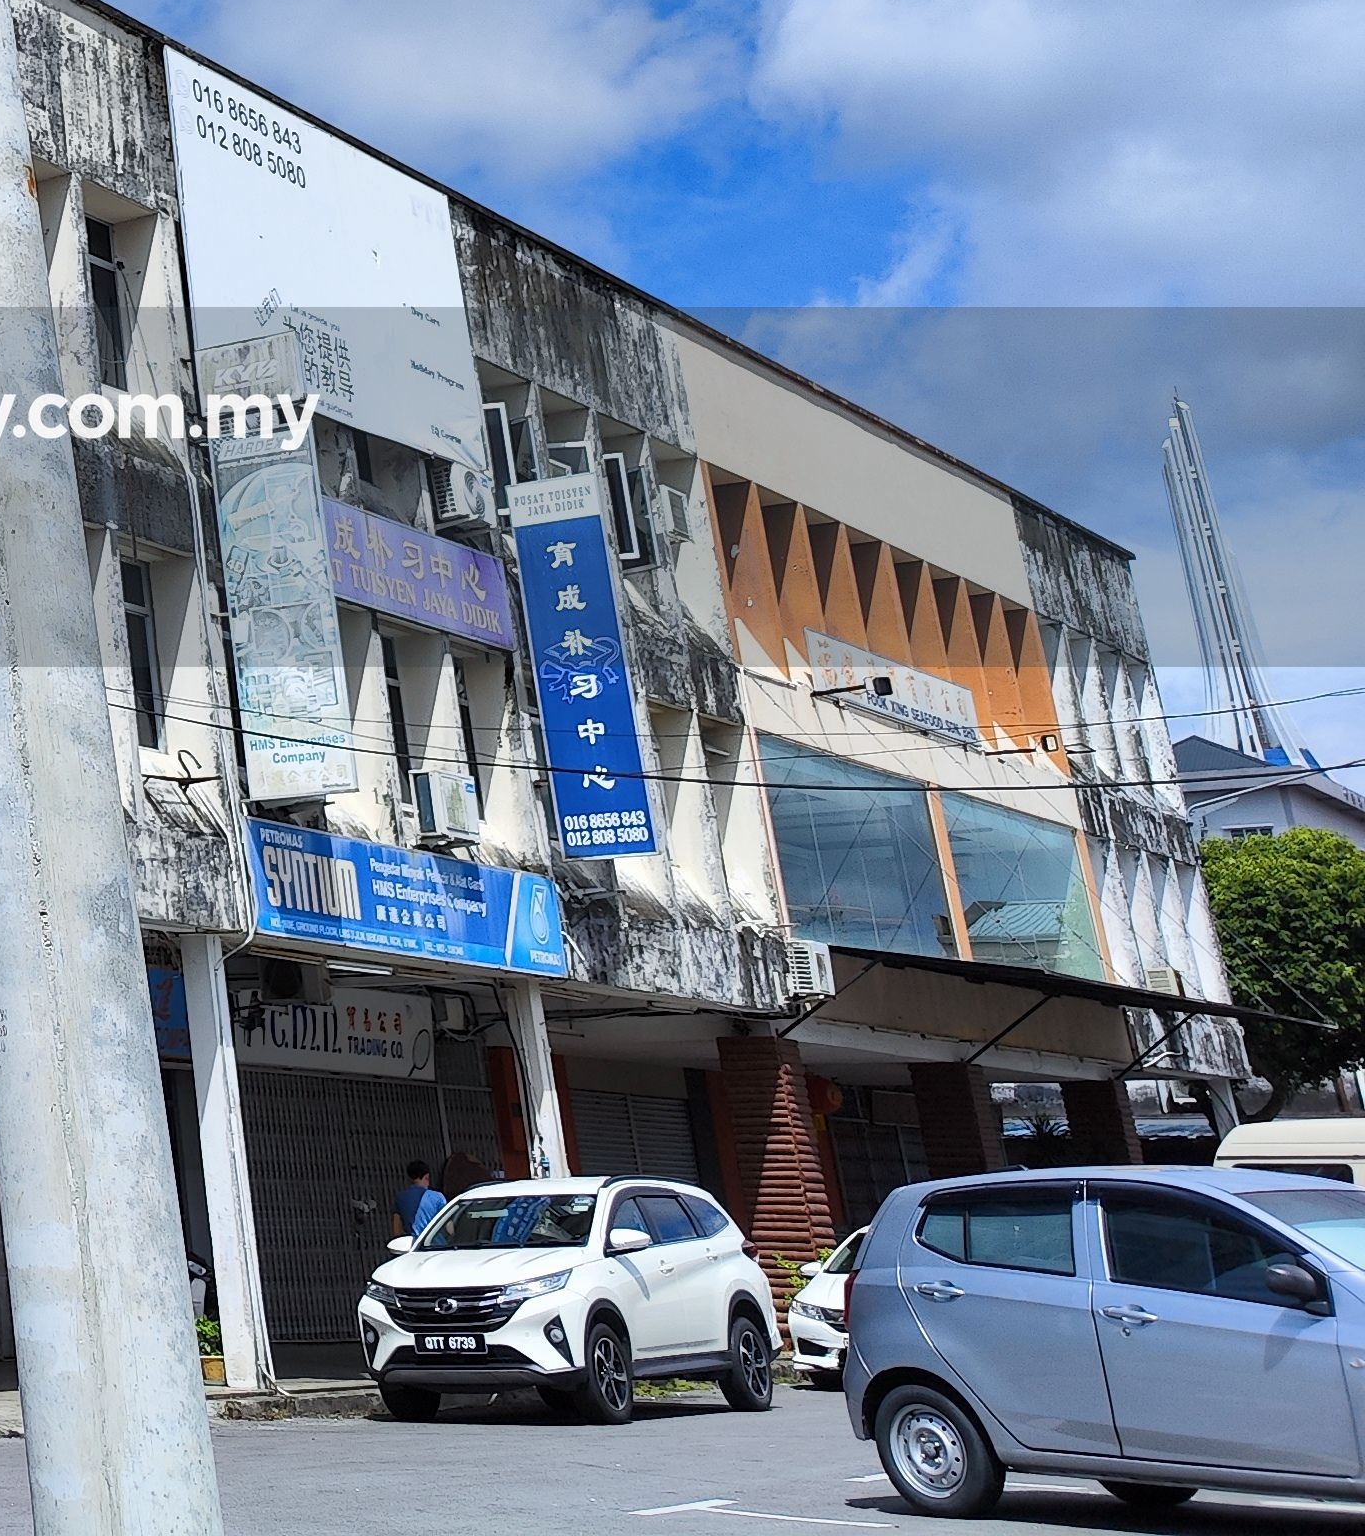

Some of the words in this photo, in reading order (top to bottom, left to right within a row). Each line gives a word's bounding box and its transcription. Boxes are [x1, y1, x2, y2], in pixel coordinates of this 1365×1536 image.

[193, 79, 223, 113] 016
[228, 97, 268, 137] 8656
[272, 121, 301, 154] 843
[197, 115, 228, 150] 012
[232, 133, 262, 166] 808
[267, 151, 305, 188] 5080
[514, 492, 544, 507] PUSAT
[548, 486, 591, 503] TUISYEN
[528, 504, 551, 517] JAYA
[555, 498, 584, 512] DIDIK
[350, 564, 417, 606] TUISYEN
[422, 588, 460, 621] JAYA
[461, 601, 503, 635] DIDIK
[546, 541, 616, 790] 育成补习中心
[911, 708, 943, 729] SEAFOOD
[250, 738, 275, 751] HMS
[280, 733, 346, 750] Enprises
[273, 751, 326, 764] Company
[564, 815, 588, 830] 016
[589, 812, 620, 829] 8656
[621, 810, 646, 826] 843
[260, 827, 303, 849] PETRONAS
[567, 831, 591, 846] 012
[592, 829, 616, 845] 808
[618, 827, 649, 842] 5080
[372, 879, 396, 898] HMS
[396, 883, 447, 907] Enterprises
[348, 1036, 387, 1057] TRADING
[425, 1337, 444, 1349] QTT
[449, 1336, 476, 1349] 6739
